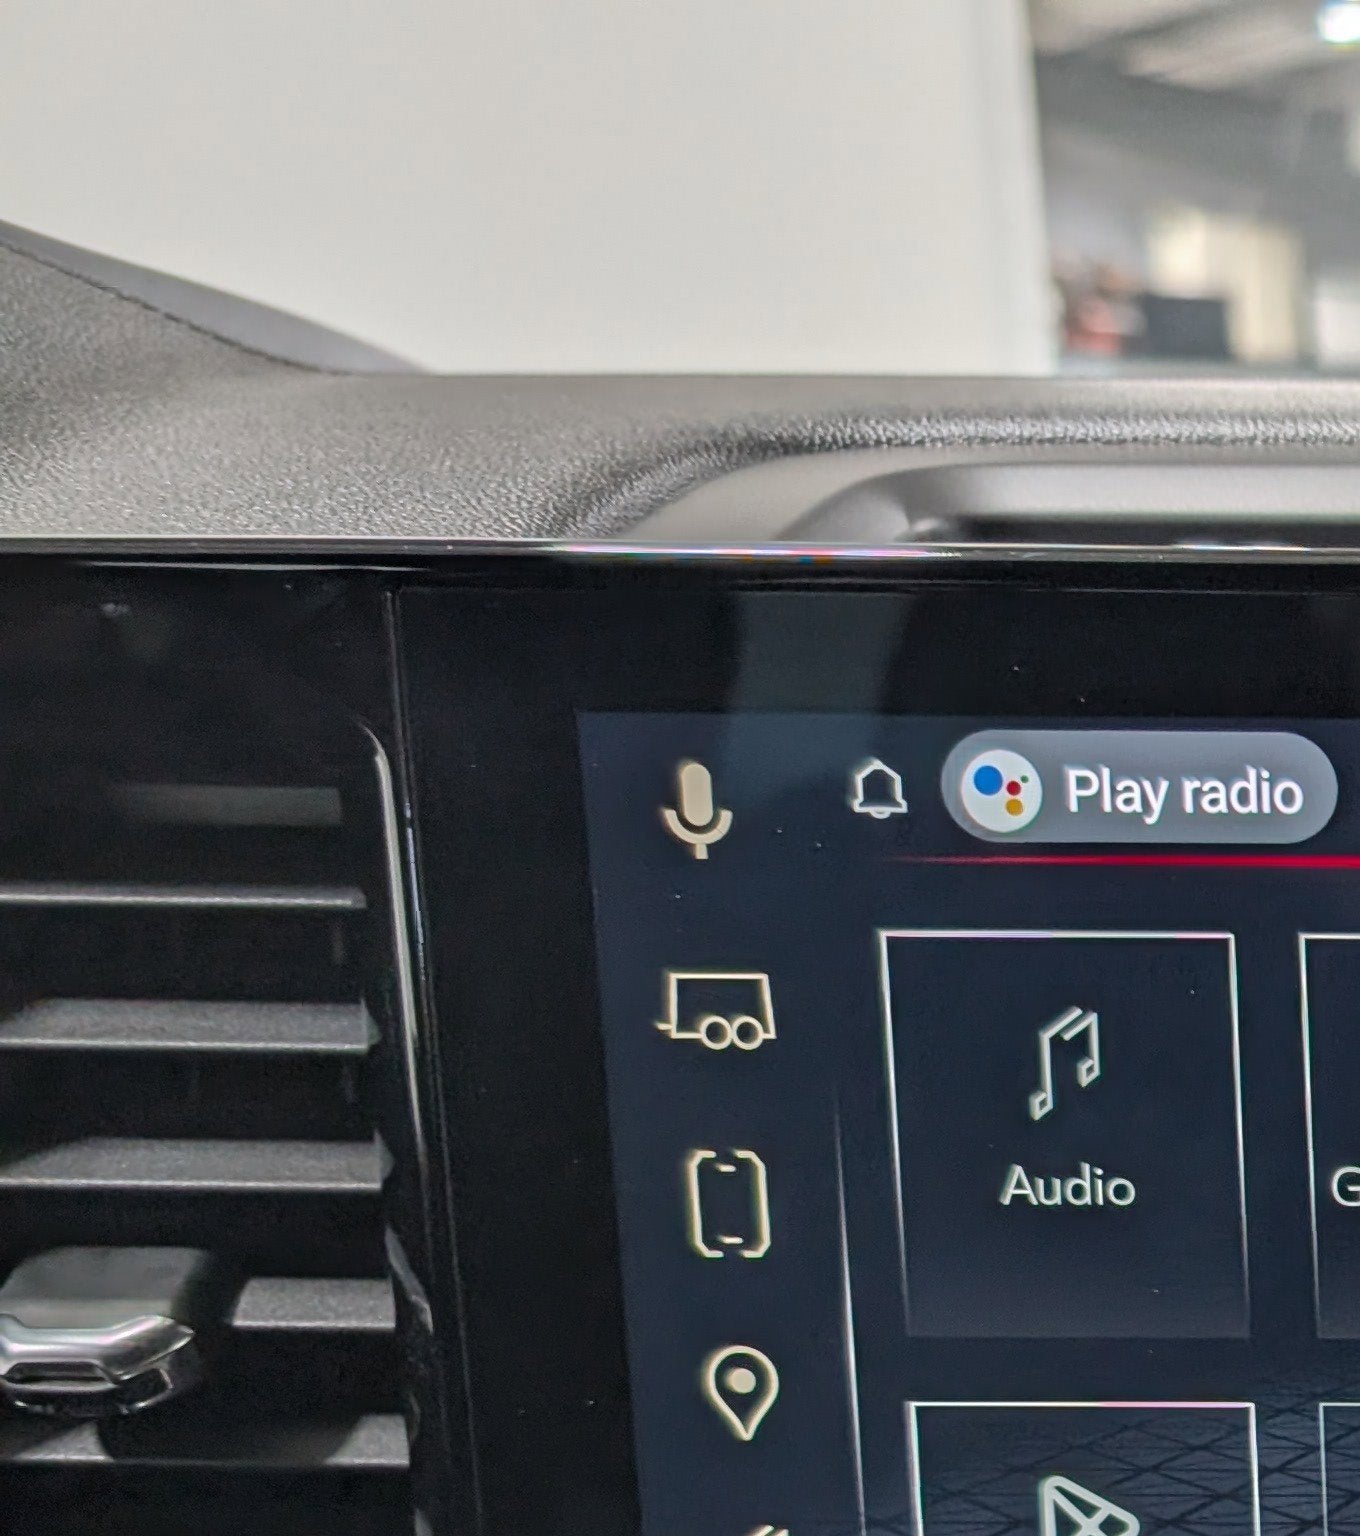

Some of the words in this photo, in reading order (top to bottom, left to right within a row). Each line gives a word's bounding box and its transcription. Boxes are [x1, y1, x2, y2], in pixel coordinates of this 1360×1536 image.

[1066, 765, 1171, 826] Play
[1182, 764, 1304, 816] radio
[999, 1161, 1137, 1207] Audio
